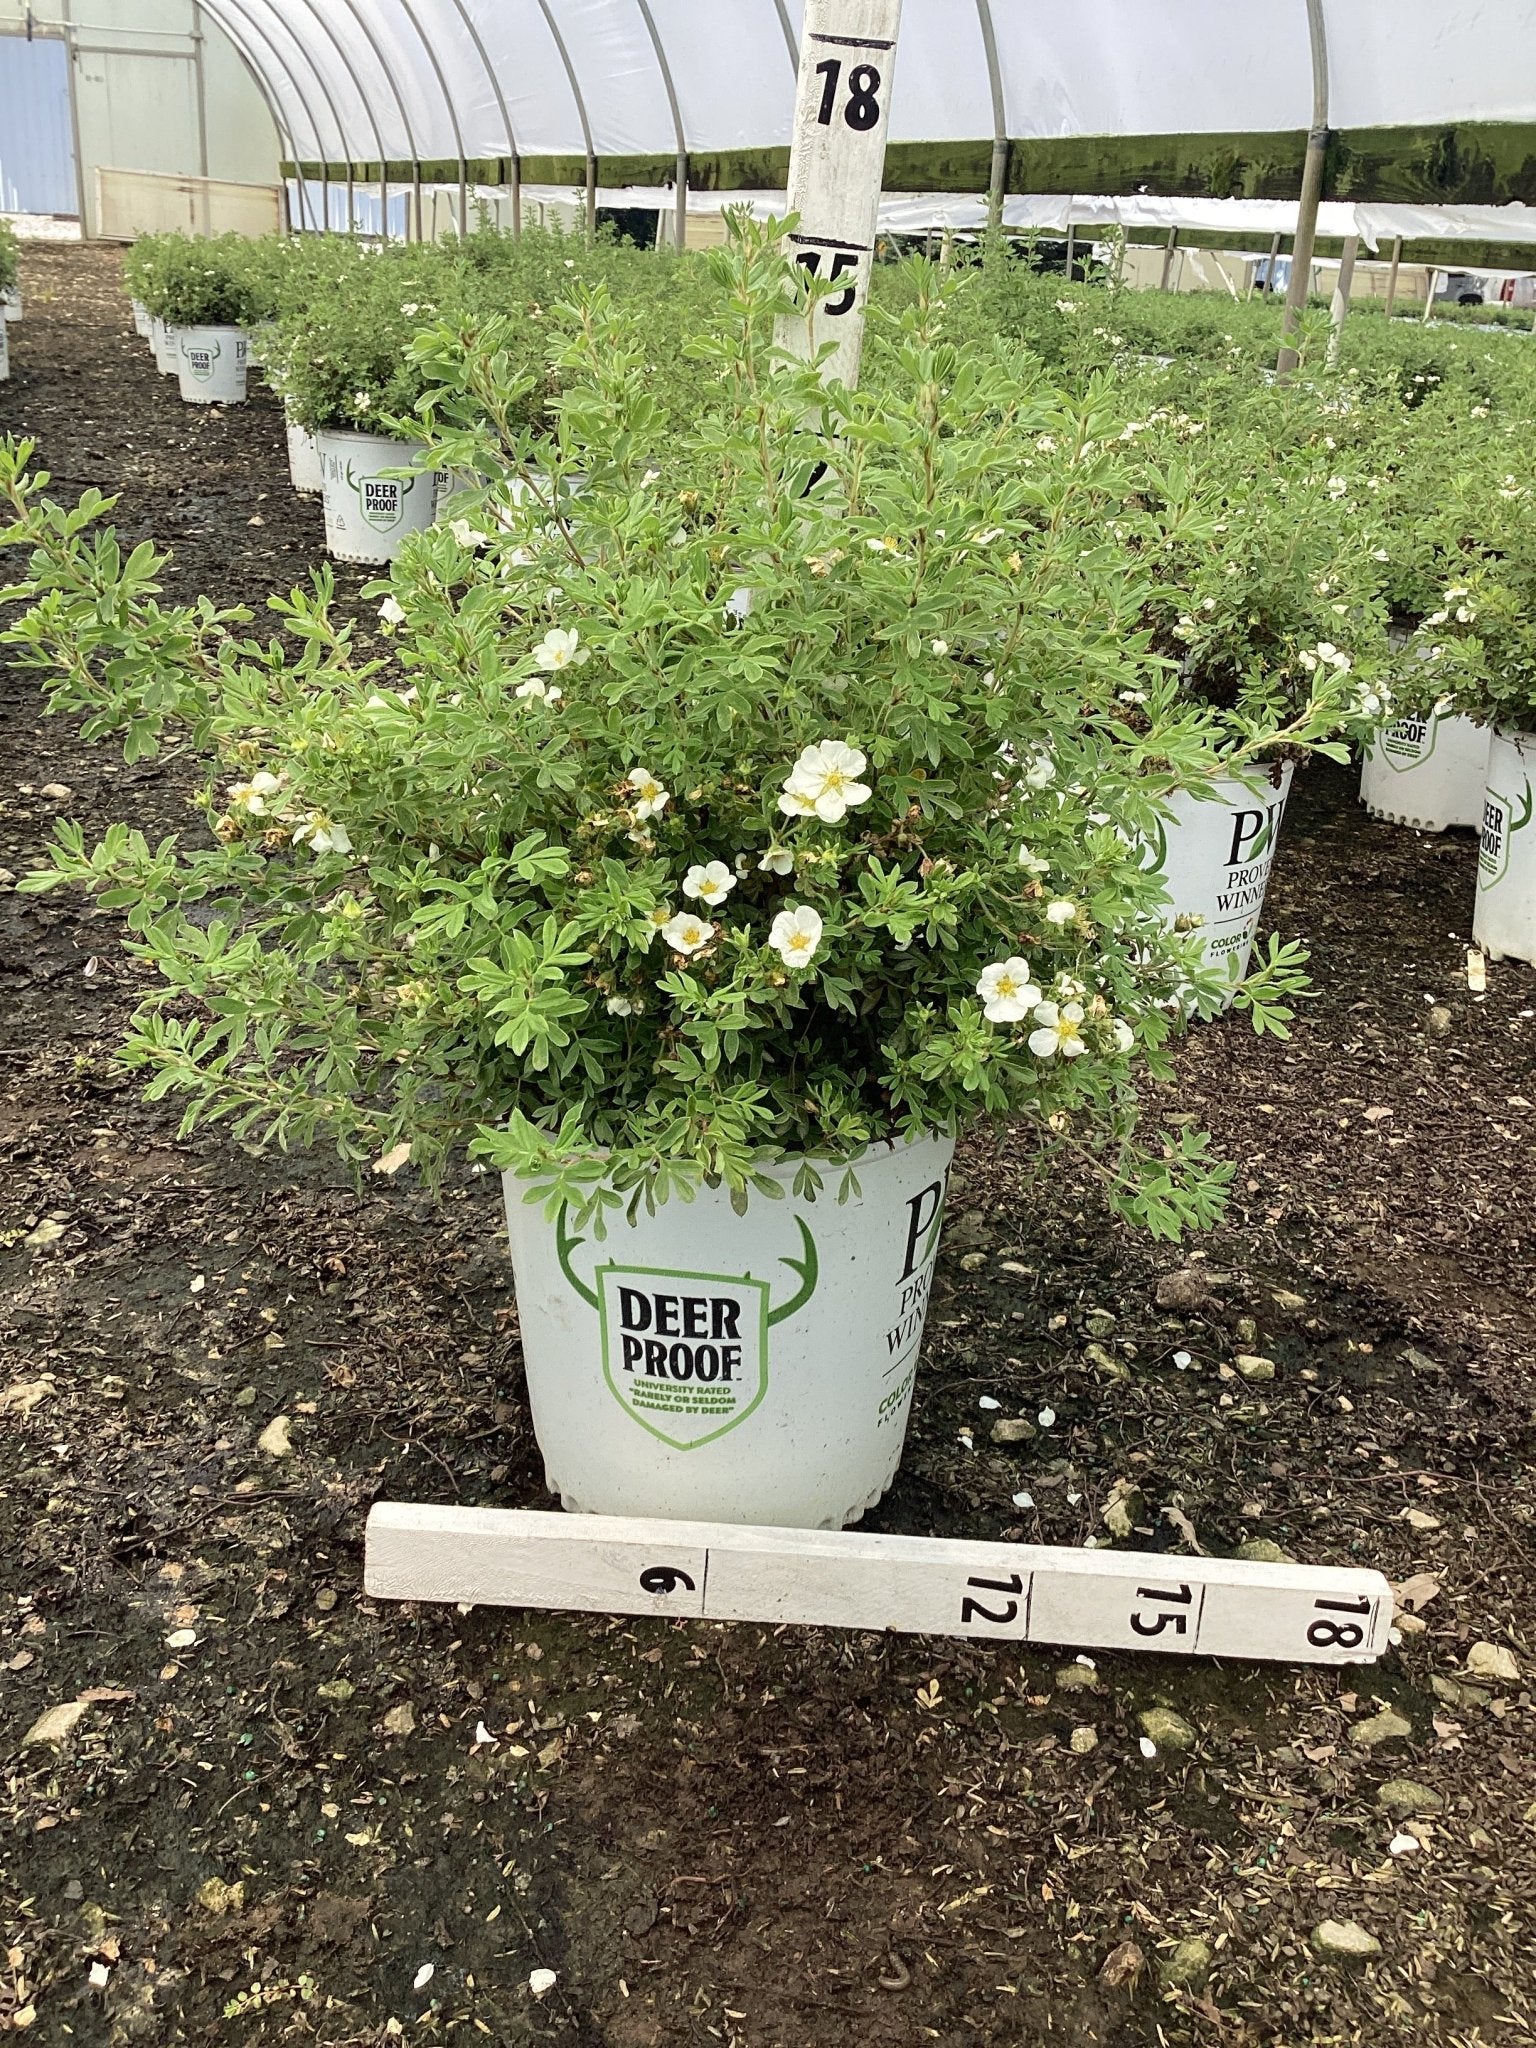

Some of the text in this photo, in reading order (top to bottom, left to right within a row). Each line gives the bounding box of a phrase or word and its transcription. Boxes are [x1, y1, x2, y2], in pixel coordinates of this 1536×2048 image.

[815, 58, 881, 131] 18
[190, 352, 209, 361] DEER
[191, 361, 209, 370] PROOF
[365, 483, 397, 498] DEER
[366, 498, 398, 512] PROOF
[1483, 800, 1503, 834] EER
[1226, 860, 1271, 889] PROVE
[1216, 881, 1265, 912] WINNE
[1211, 933, 1241, 949] COLOR
[895, 1165, 949, 1286] P
[898, 1259, 933, 1318] PRO
[617, 1286, 742, 1339] DEER
[886, 1304, 924, 1356] WIN
[621, 1333, 742, 1382] PROOF
[633, 1378, 731, 1395] UNIVERSITY RATED
[674, 1395, 690, 1404] OR
[692, 1396, 736, 1405] SELDOM
[632, 1398, 684, 1412] DAMAGED
[686, 1405, 699, 1414] BY
[640, 1566, 696, 1594] 6
[961, 1574, 1023, 1623] 12
[1130, 1584, 1192, 1636] 15
[1306, 1595, 1371, 1648] 18
